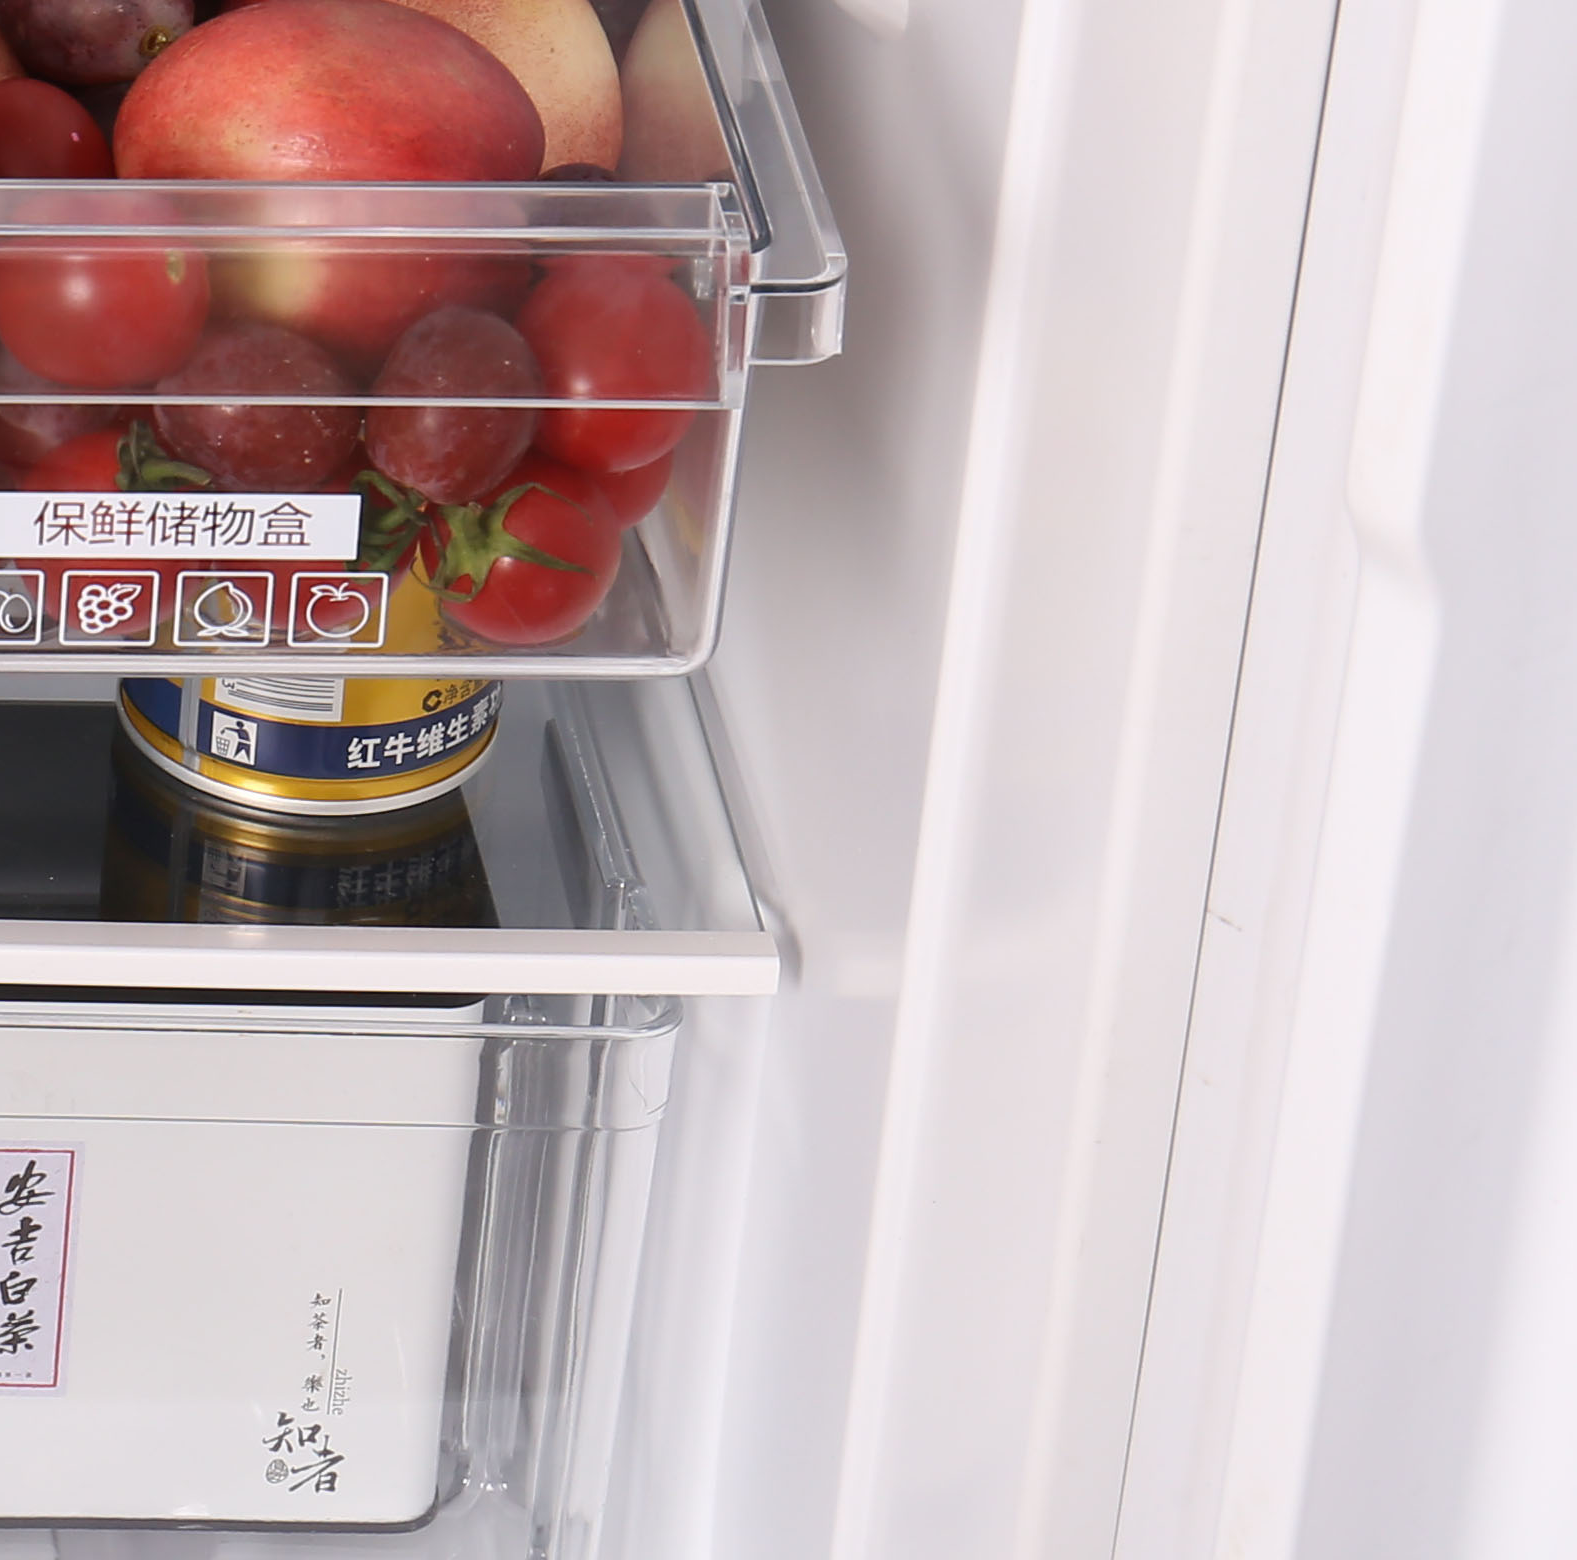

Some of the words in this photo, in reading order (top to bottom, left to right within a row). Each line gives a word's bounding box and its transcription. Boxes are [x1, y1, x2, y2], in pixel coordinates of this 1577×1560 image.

[34, 500, 313, 547] 保鲜储物盒
[332, 1368, 353, 1416] zhizhe
[262, 1411, 345, 1493] 知者
